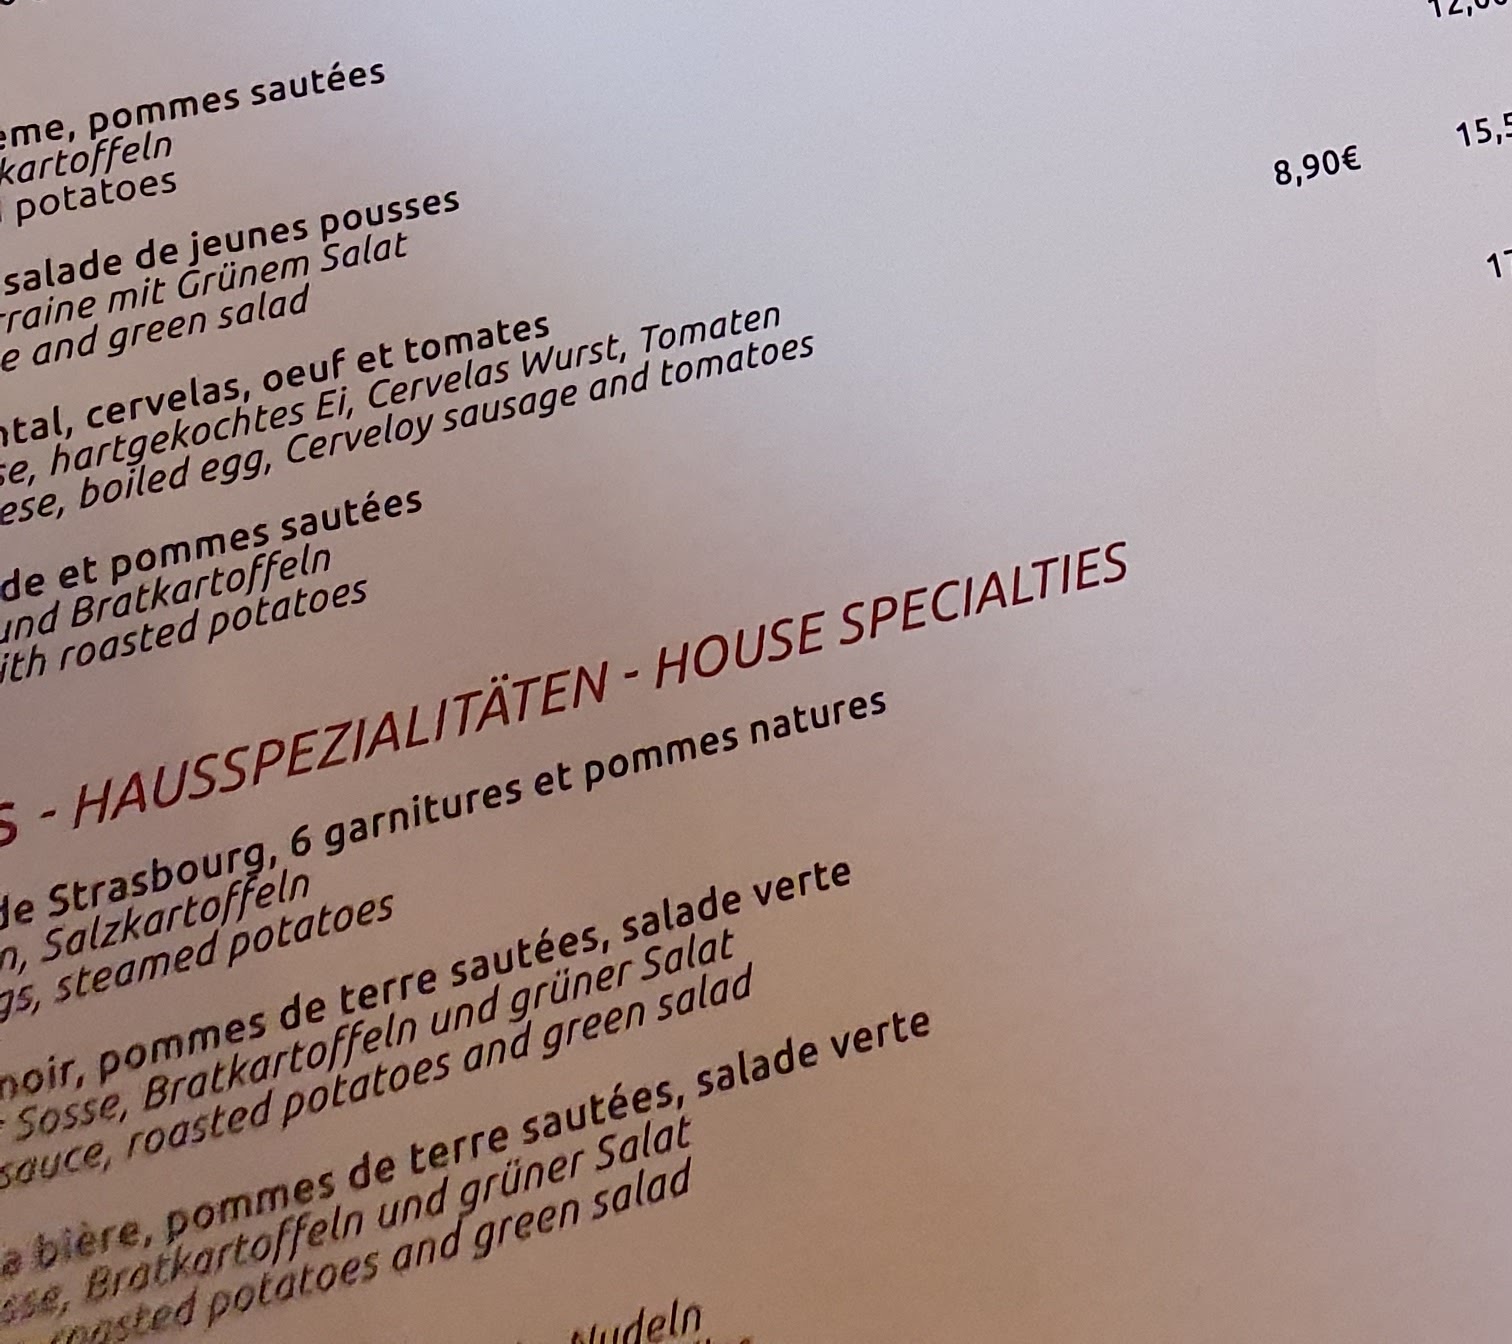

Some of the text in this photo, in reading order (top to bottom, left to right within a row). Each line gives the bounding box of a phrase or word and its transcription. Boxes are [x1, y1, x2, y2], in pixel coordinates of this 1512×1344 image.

[88, 87, 240, 141] pommes
[250, 60, 386, 106] sautées
[15, 170, 177, 228] potatoes
[1273, 144, 1362, 188] 8,90€
[0, 231, 409, 335] raine mit Grünem Salat
[3, 190, 460, 297] salade de jeunes pousses
[31, 322, 99, 367] and
[106, 311, 207, 359] green
[216, 281, 310, 330] salad
[86, 376, 251, 430] cervelas,
[262, 346, 347, 393] oeuf
[356, 342, 395, 374] et
[404, 315, 550, 364] tomates
[49, 401, 307, 477] hartgekochtes
[315, 385, 354, 421] Ei,
[367, 358, 510, 409] Cervelas
[521, 333, 627, 378] Wurst,
[639, 306, 780, 354] Tomaten
[78, 453, 191, 510] boiled
[200, 448, 272, 486] egg,
[286, 412, 435, 464] Cerveloy
[441, 384, 578, 433] sausage
[589, 359, 650, 402] and
[660, 334, 815, 387] tomatoes
[0, 489, 423, 604] de et pommes sautées
[70, 542, 331, 629] Bratkartoffeln
[58, 607, 200, 672] roasted
[207, 579, 368, 646] potatoes
[71, 660, 609, 831] HAUSSPEZIALITÄTEN
[654, 609, 826, 690] HOUSE
[839, 540, 1127, 646] SPECIALTIES
[47, 841, 278, 919] Strasbourg,
[290, 823, 314, 858] 6
[324, 778, 523, 858] garnitures
[533, 761, 573, 797] et
[584, 726, 739, 793] pommes
[749, 690, 887, 745] natures
[39, 867, 310, 965] Salzkartoffeln
[53, 928, 218, 1004] steamed
[228, 893, 396, 968] potatoes
[98, 1010, 268, 1089] pommes
[279, 991, 327, 1032] de
[339, 968, 438, 1017] terre
[450, 925, 610, 988] sautées,
[622, 884, 742, 944] salade
[752, 861, 851, 907] verte
[14, 927, 736, 1144] Sosse, Bratkartoffeln und grüner Salat
[126, 1088, 273, 1161] roasted
[281, 1050, 453, 1130] potatoes
[462, 1020, 533, 1074] and
[542, 1001, 647, 1061] green
[656, 960, 754, 1023] salad
[164, 1169, 337, 1248] pommes
[347, 1150, 396, 1194] de
[409, 1124, 509, 1176] terre
[522, 1079, 685, 1146] sautées,
[696, 1034, 819, 1100] salade
[829, 1011, 931, 1060] verte
[85, 1204, 365, 1303] Bratkartoffeln
[376, 1174, 450, 1231] und
[458, 1147, 587, 1218] grüner
[595, 1113, 693, 1175] Salat
[207, 1249, 381, 1329] potatoes
[390, 1217, 462, 1273] and
[472, 1196, 581, 1262] green
[590, 1154, 693, 1223] salad
